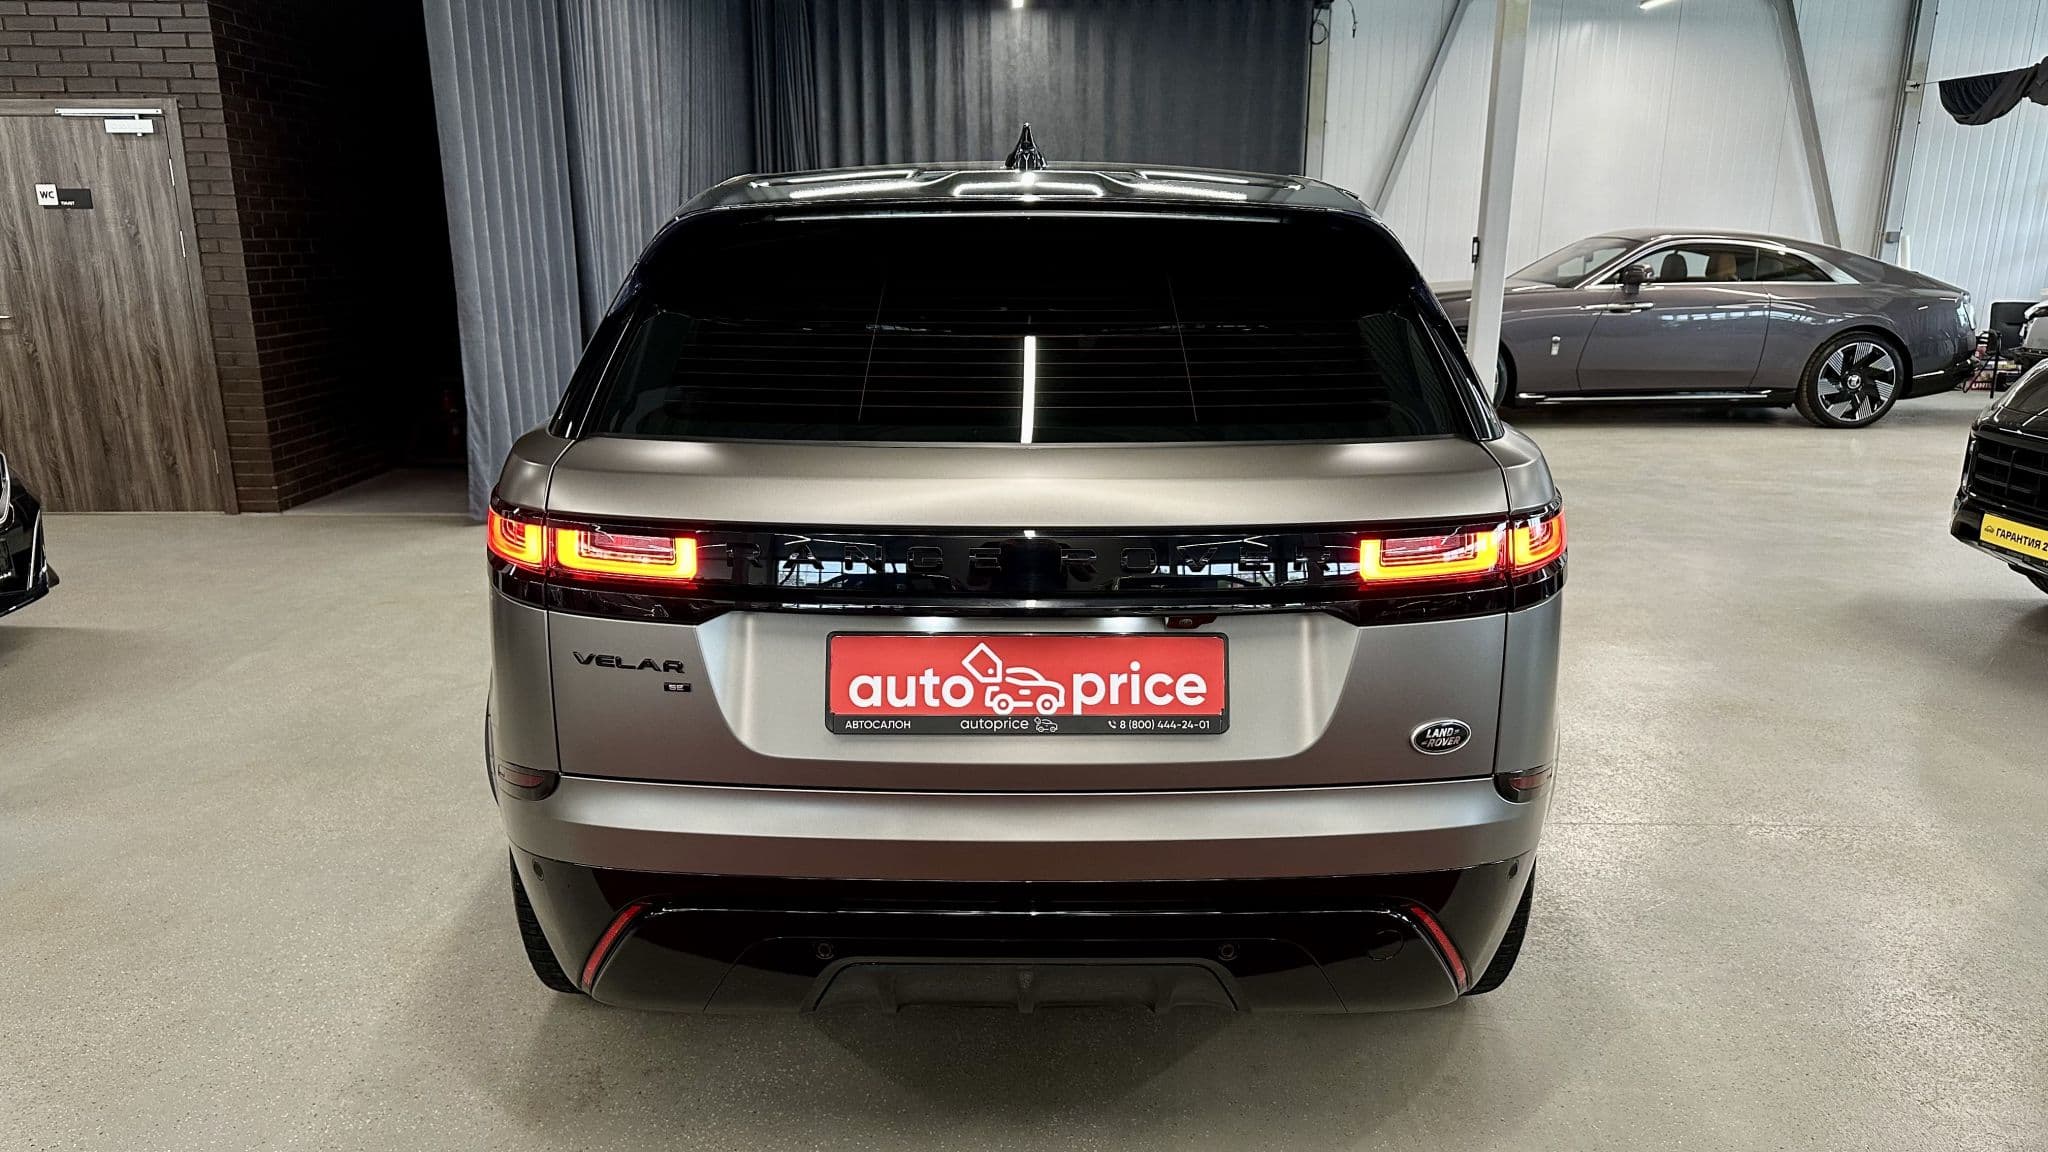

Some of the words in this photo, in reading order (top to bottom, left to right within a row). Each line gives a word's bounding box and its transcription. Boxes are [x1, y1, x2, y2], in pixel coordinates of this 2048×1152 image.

[40, 191, 55, 199] WC
[1996, 528, 2041, 550] ГАРАНТИЯ
[725, 543, 1002, 570] RANGE
[1061, 546, 1332, 572] ROVER
[573, 651, 685, 674] VELAR
[848, 668, 974, 708] auto
[1073, 661, 1207, 715] price
[845, 720, 911, 730] АВТОСАЛОН
[960, 718, 1029, 732] autoprice
[1119, 720, 1127, 730] 8
[1129, 719, 1155, 731] (800)
[1158, 720, 1210, 730] 444-24-01
[1426, 728, 1454, 738] LAND
[1427, 736, 1461, 747] ROVER
